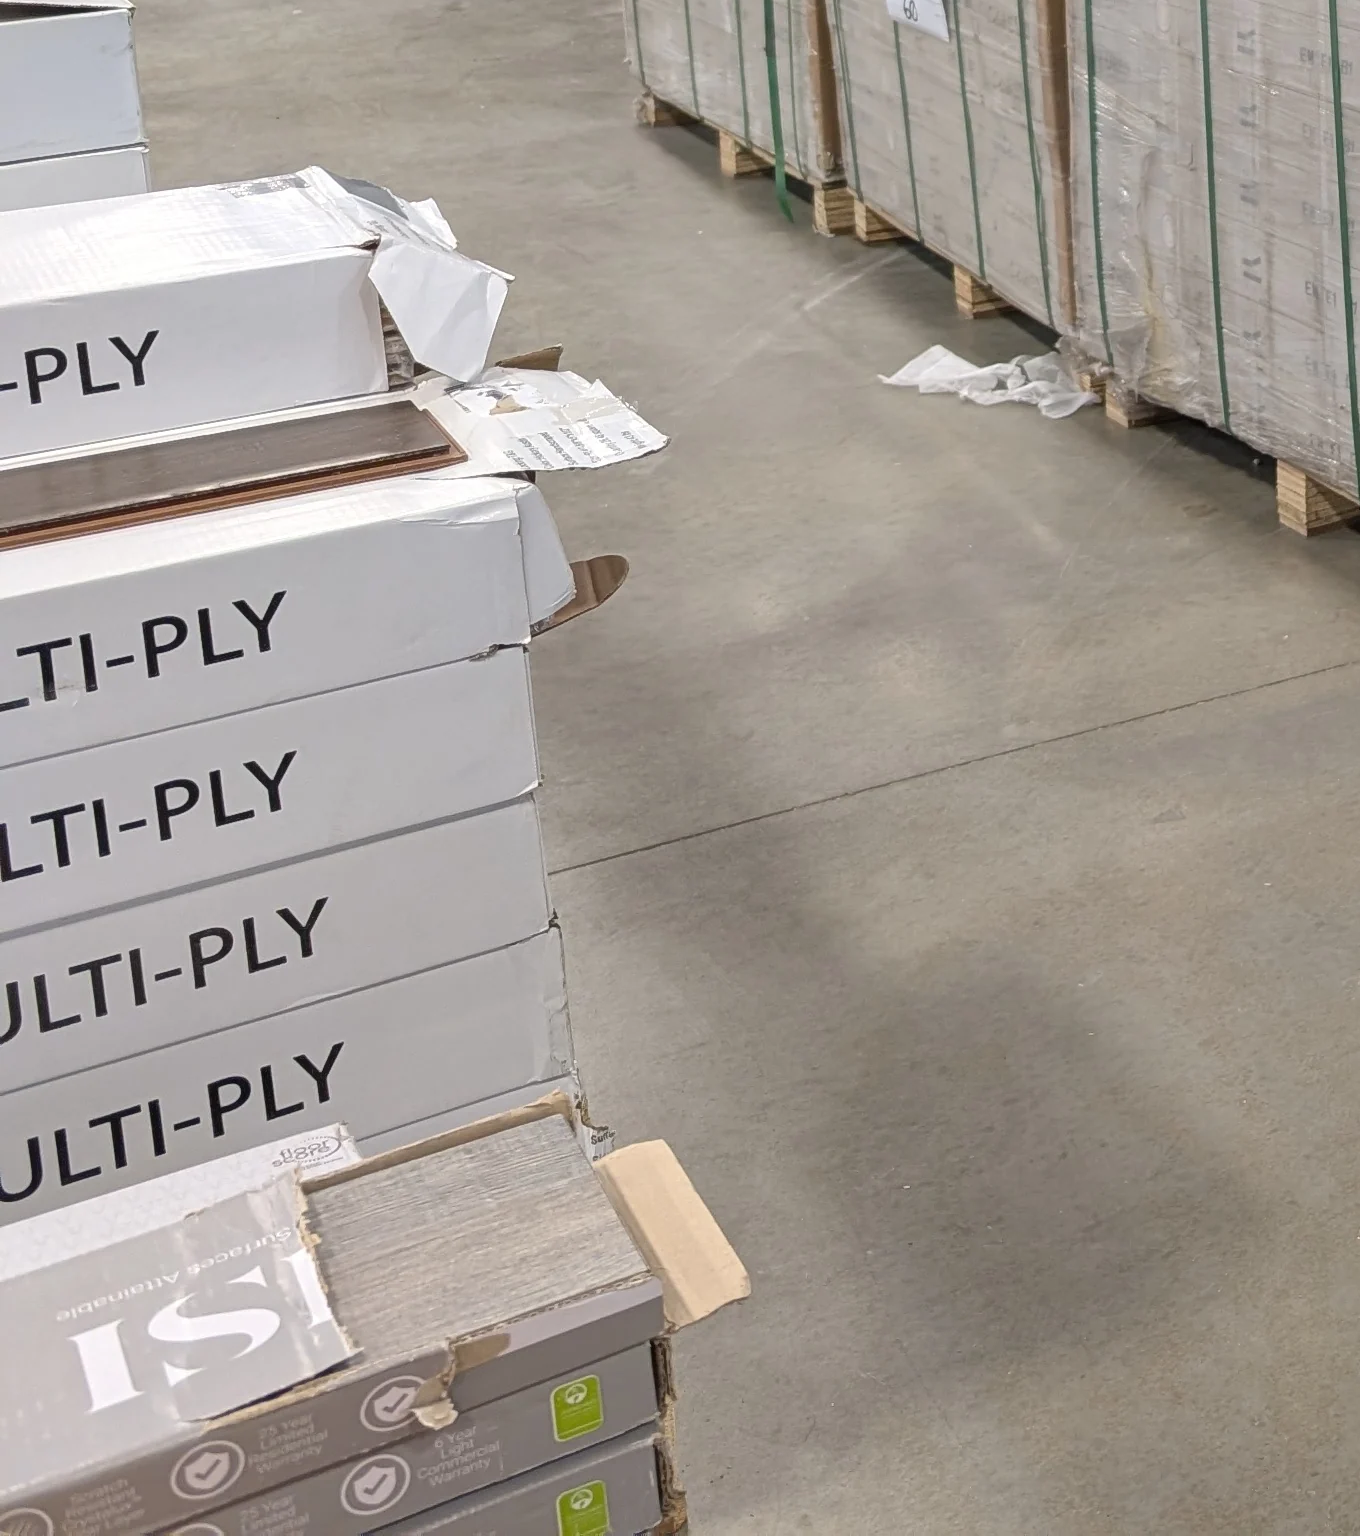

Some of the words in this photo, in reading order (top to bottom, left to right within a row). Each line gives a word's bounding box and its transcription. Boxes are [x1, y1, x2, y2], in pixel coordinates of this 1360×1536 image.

[187, 1226, 292, 1275] Surfaces
[56, 1270, 181, 1322] Attainable
[260, 1425, 315, 1450] Limited
[435, 1437, 444, 1448] 6
[449, 1426, 477, 1443] Year
[441, 1440, 475, 1459] Light
[417, 1441, 500, 1479] Commercial
[429, 1458, 491, 1487] Warranty
